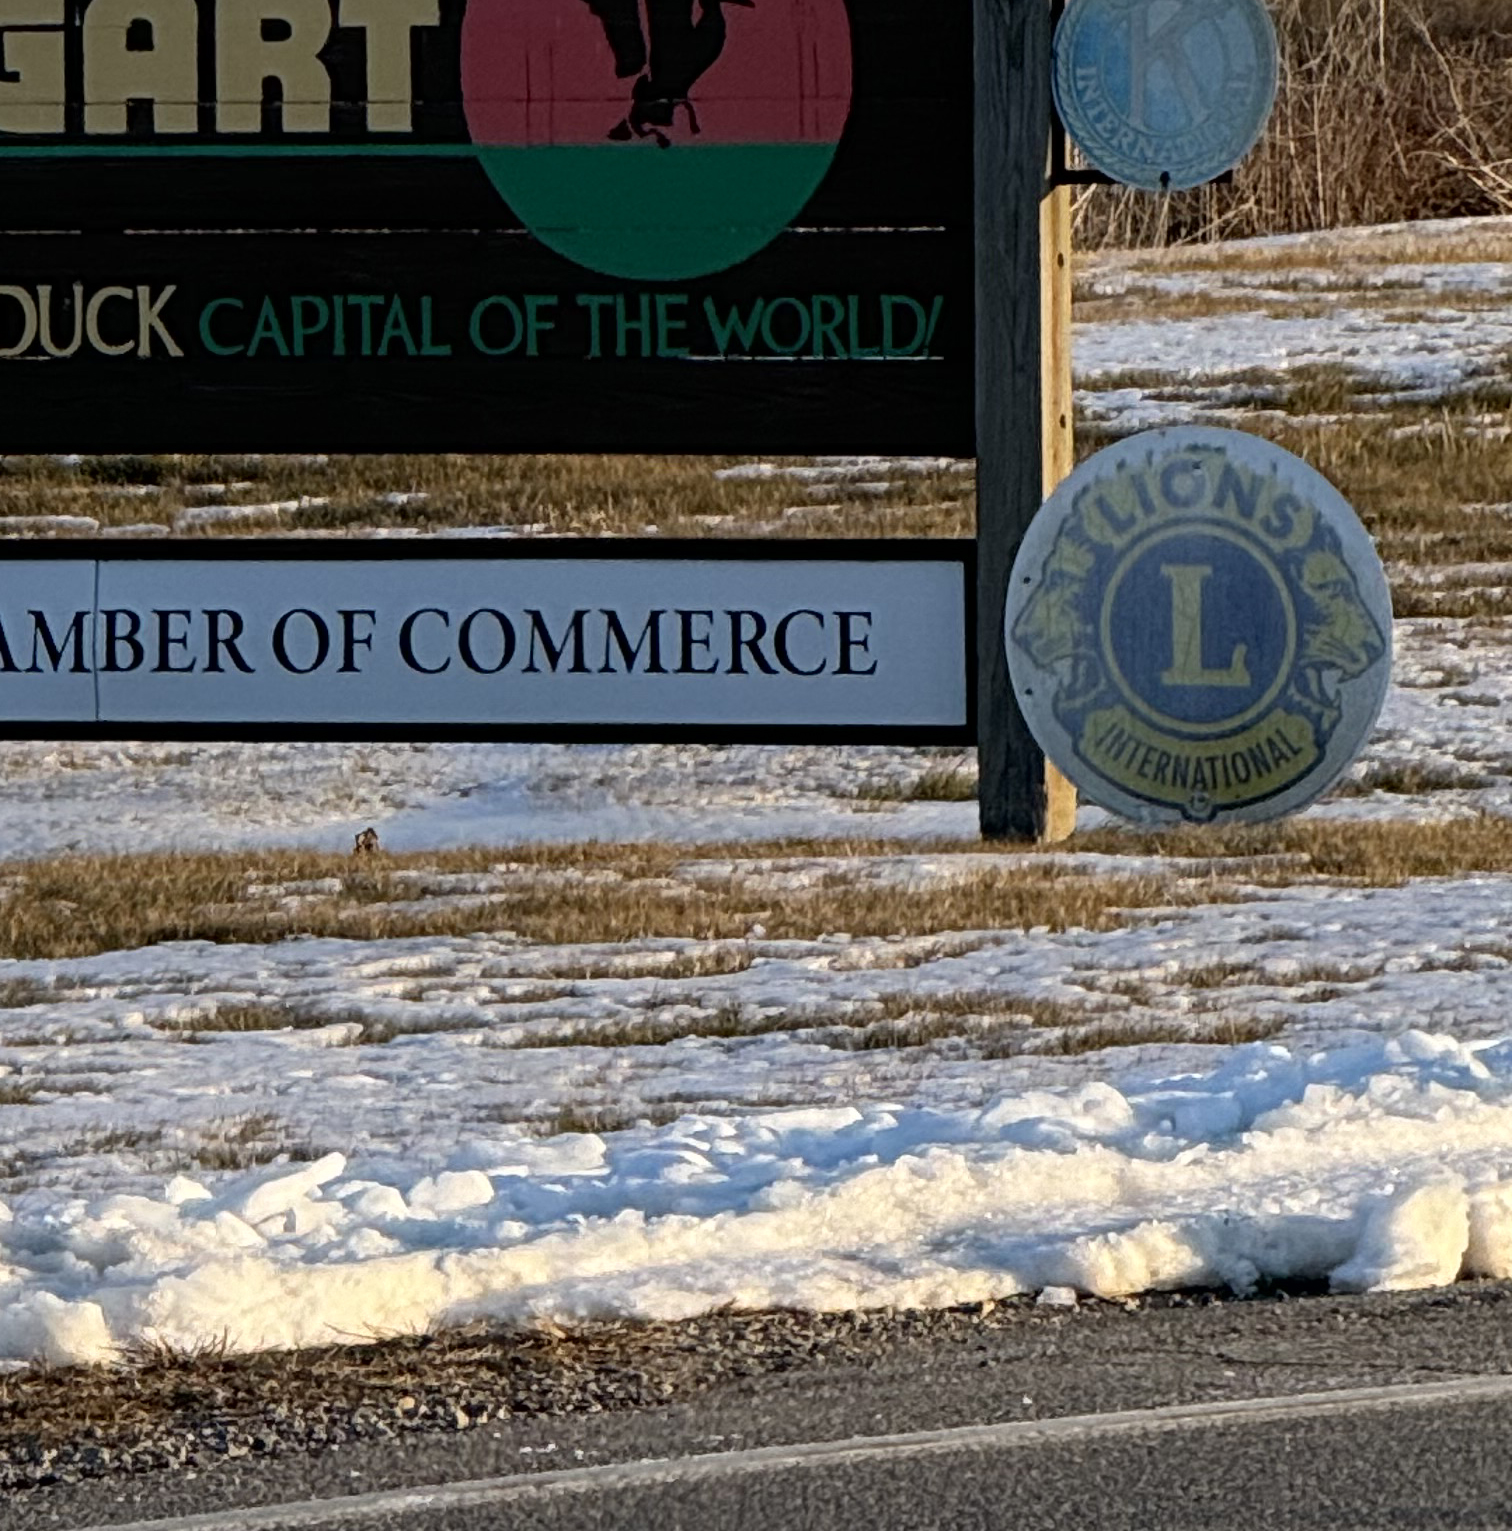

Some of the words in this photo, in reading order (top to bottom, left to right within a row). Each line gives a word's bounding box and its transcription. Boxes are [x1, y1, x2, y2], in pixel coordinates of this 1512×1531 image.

[1074, 67, 1251, 161] INTERNATIOL
[198, 295, 451, 356] CAPITAL
[469, 294, 558, 356] OF
[576, 294, 686, 357] THE
[702, 294, 943, 358] WORLD!
[1094, 458, 1302, 538] LIONS
[271, 607, 377, 675] OF
[399, 608, 878, 677] COMMERCE
[1160, 565, 1252, 686] L
[1095, 721, 1302, 790] INTERNATIONAL
